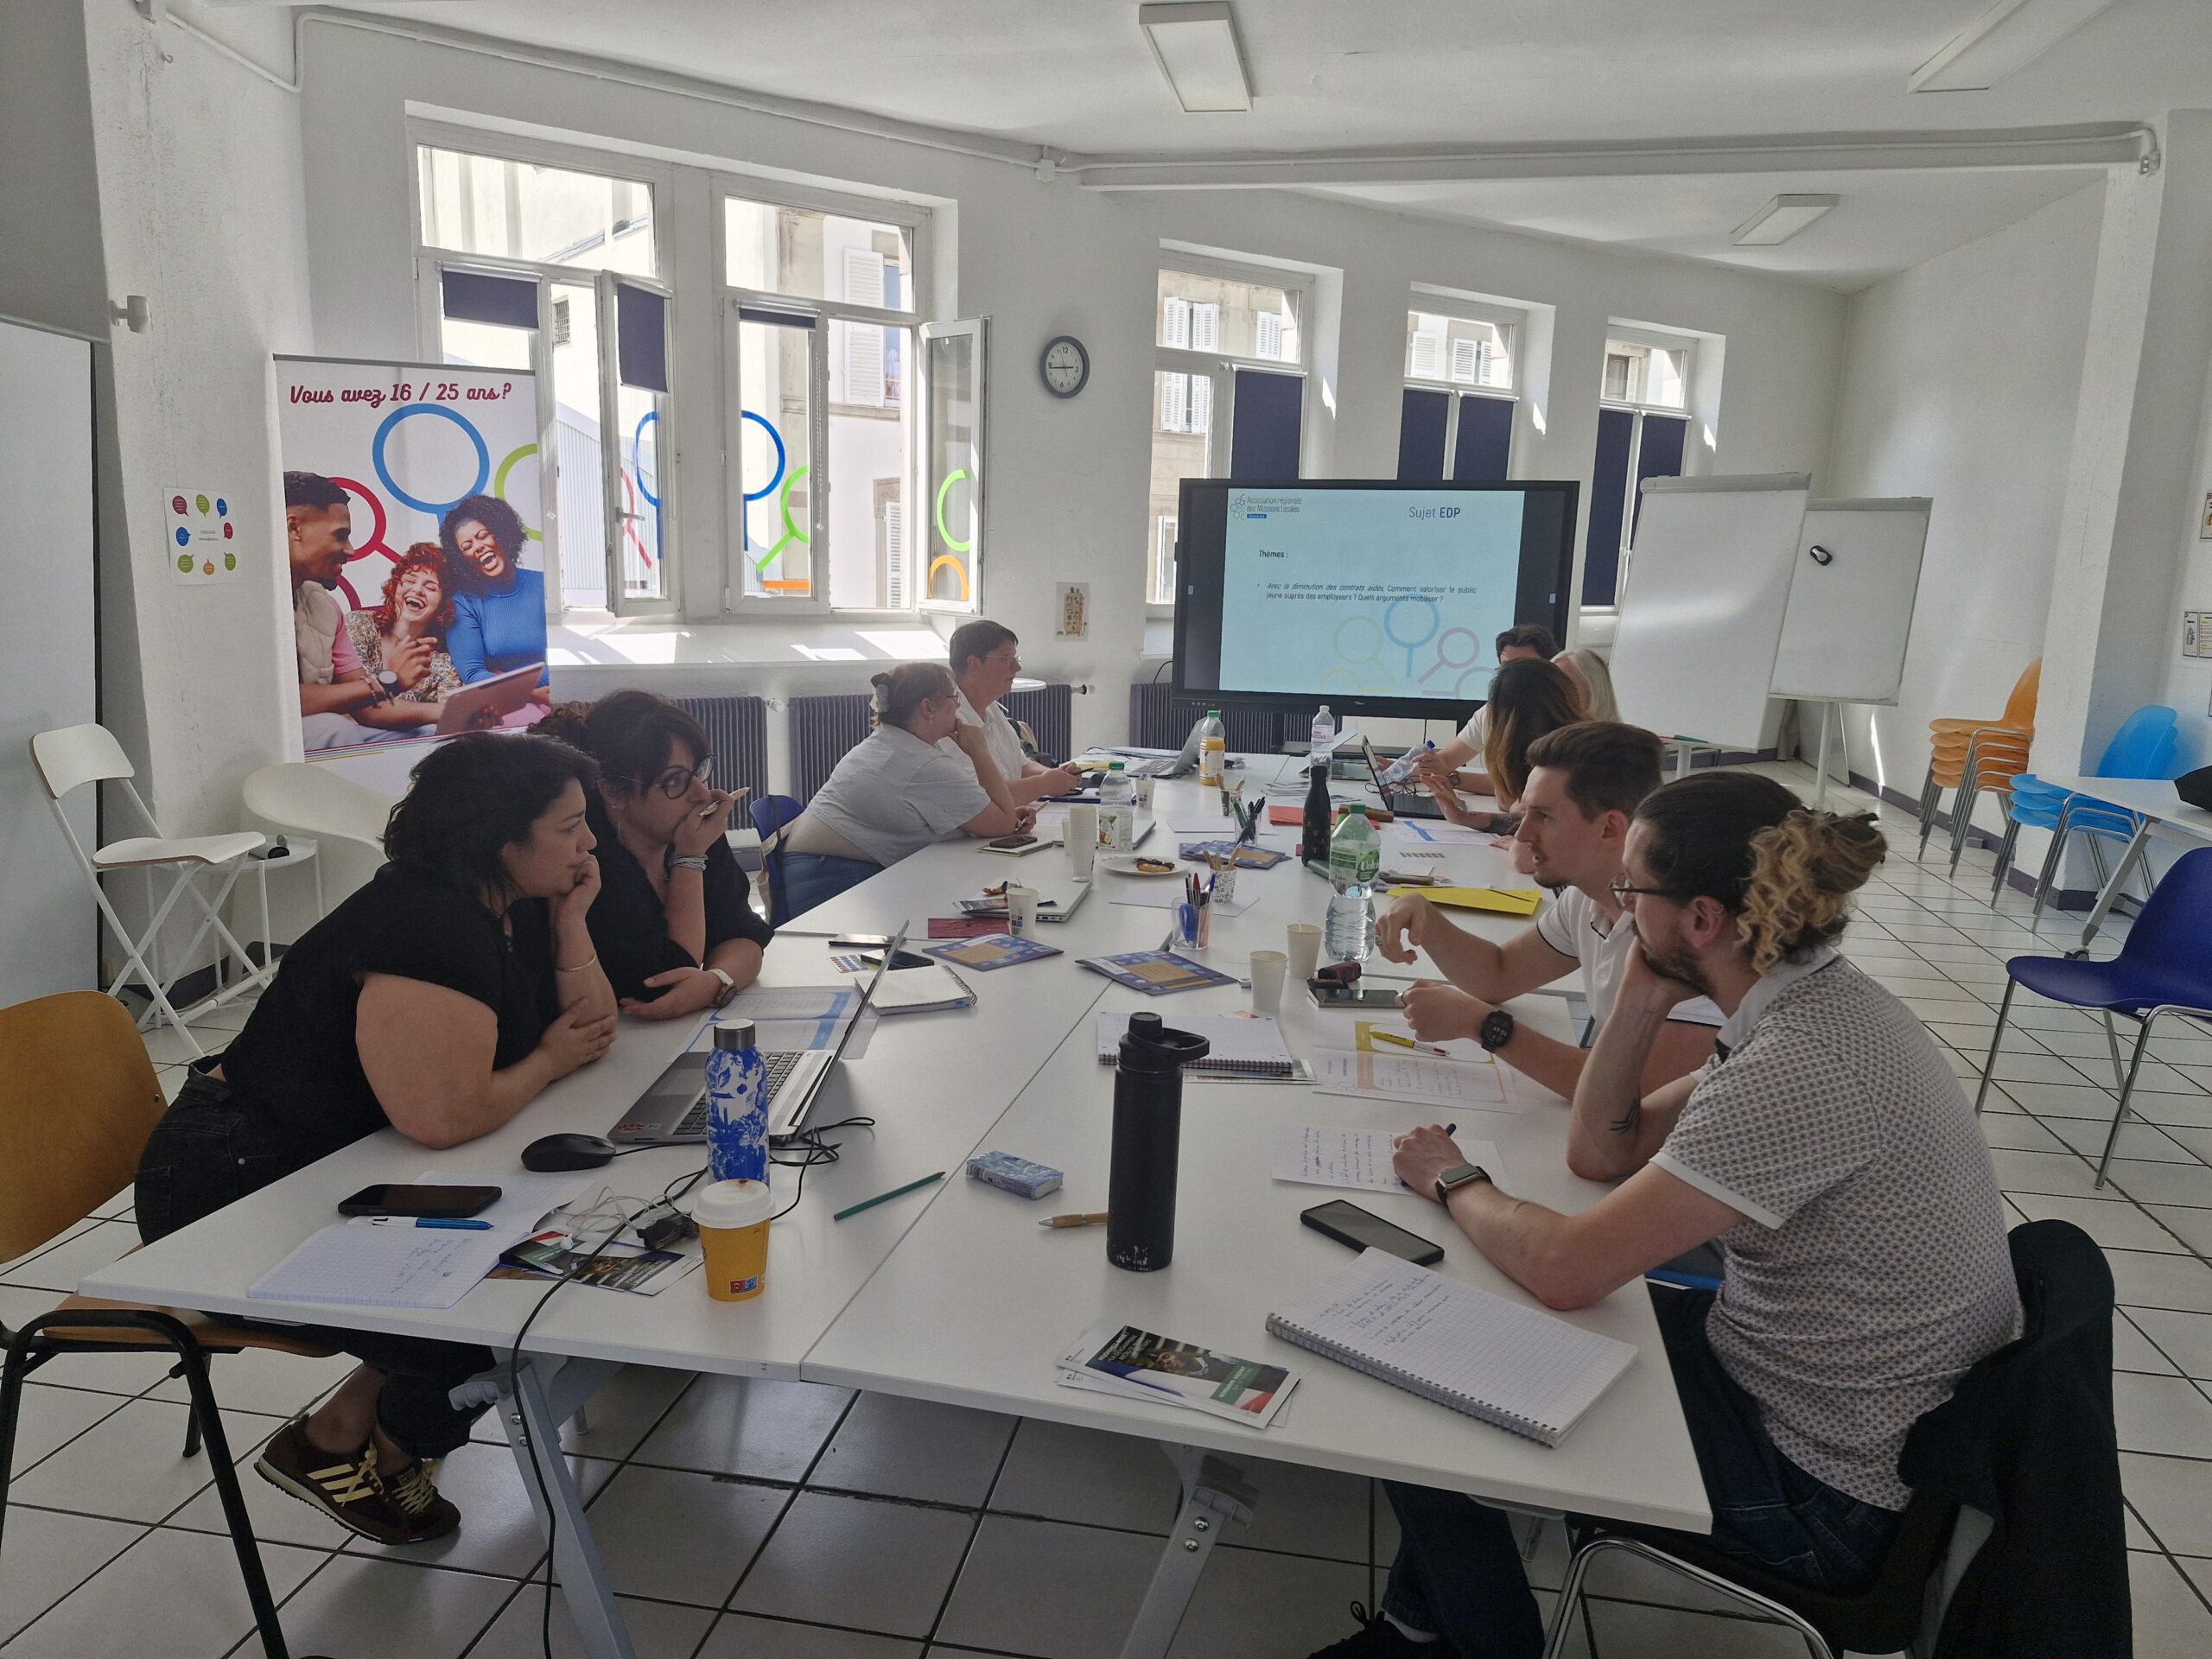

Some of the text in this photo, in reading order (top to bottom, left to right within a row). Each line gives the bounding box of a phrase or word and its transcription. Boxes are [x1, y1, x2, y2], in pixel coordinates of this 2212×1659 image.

[289, 385, 335, 404] Vous
[340, 388, 387, 409] avez
[390, 383, 411, 402] 16
[419, 382, 430, 401] /
[435, 383, 459, 401] 25
[1408, 506, 1461, 521] Sujet EDP
[1387, 584, 1417, 593] Comment
[1419, 585, 1446, 594] valoriser
[1458, 586, 1477, 594] public
[1318, 593, 1352, 601] employeurs
